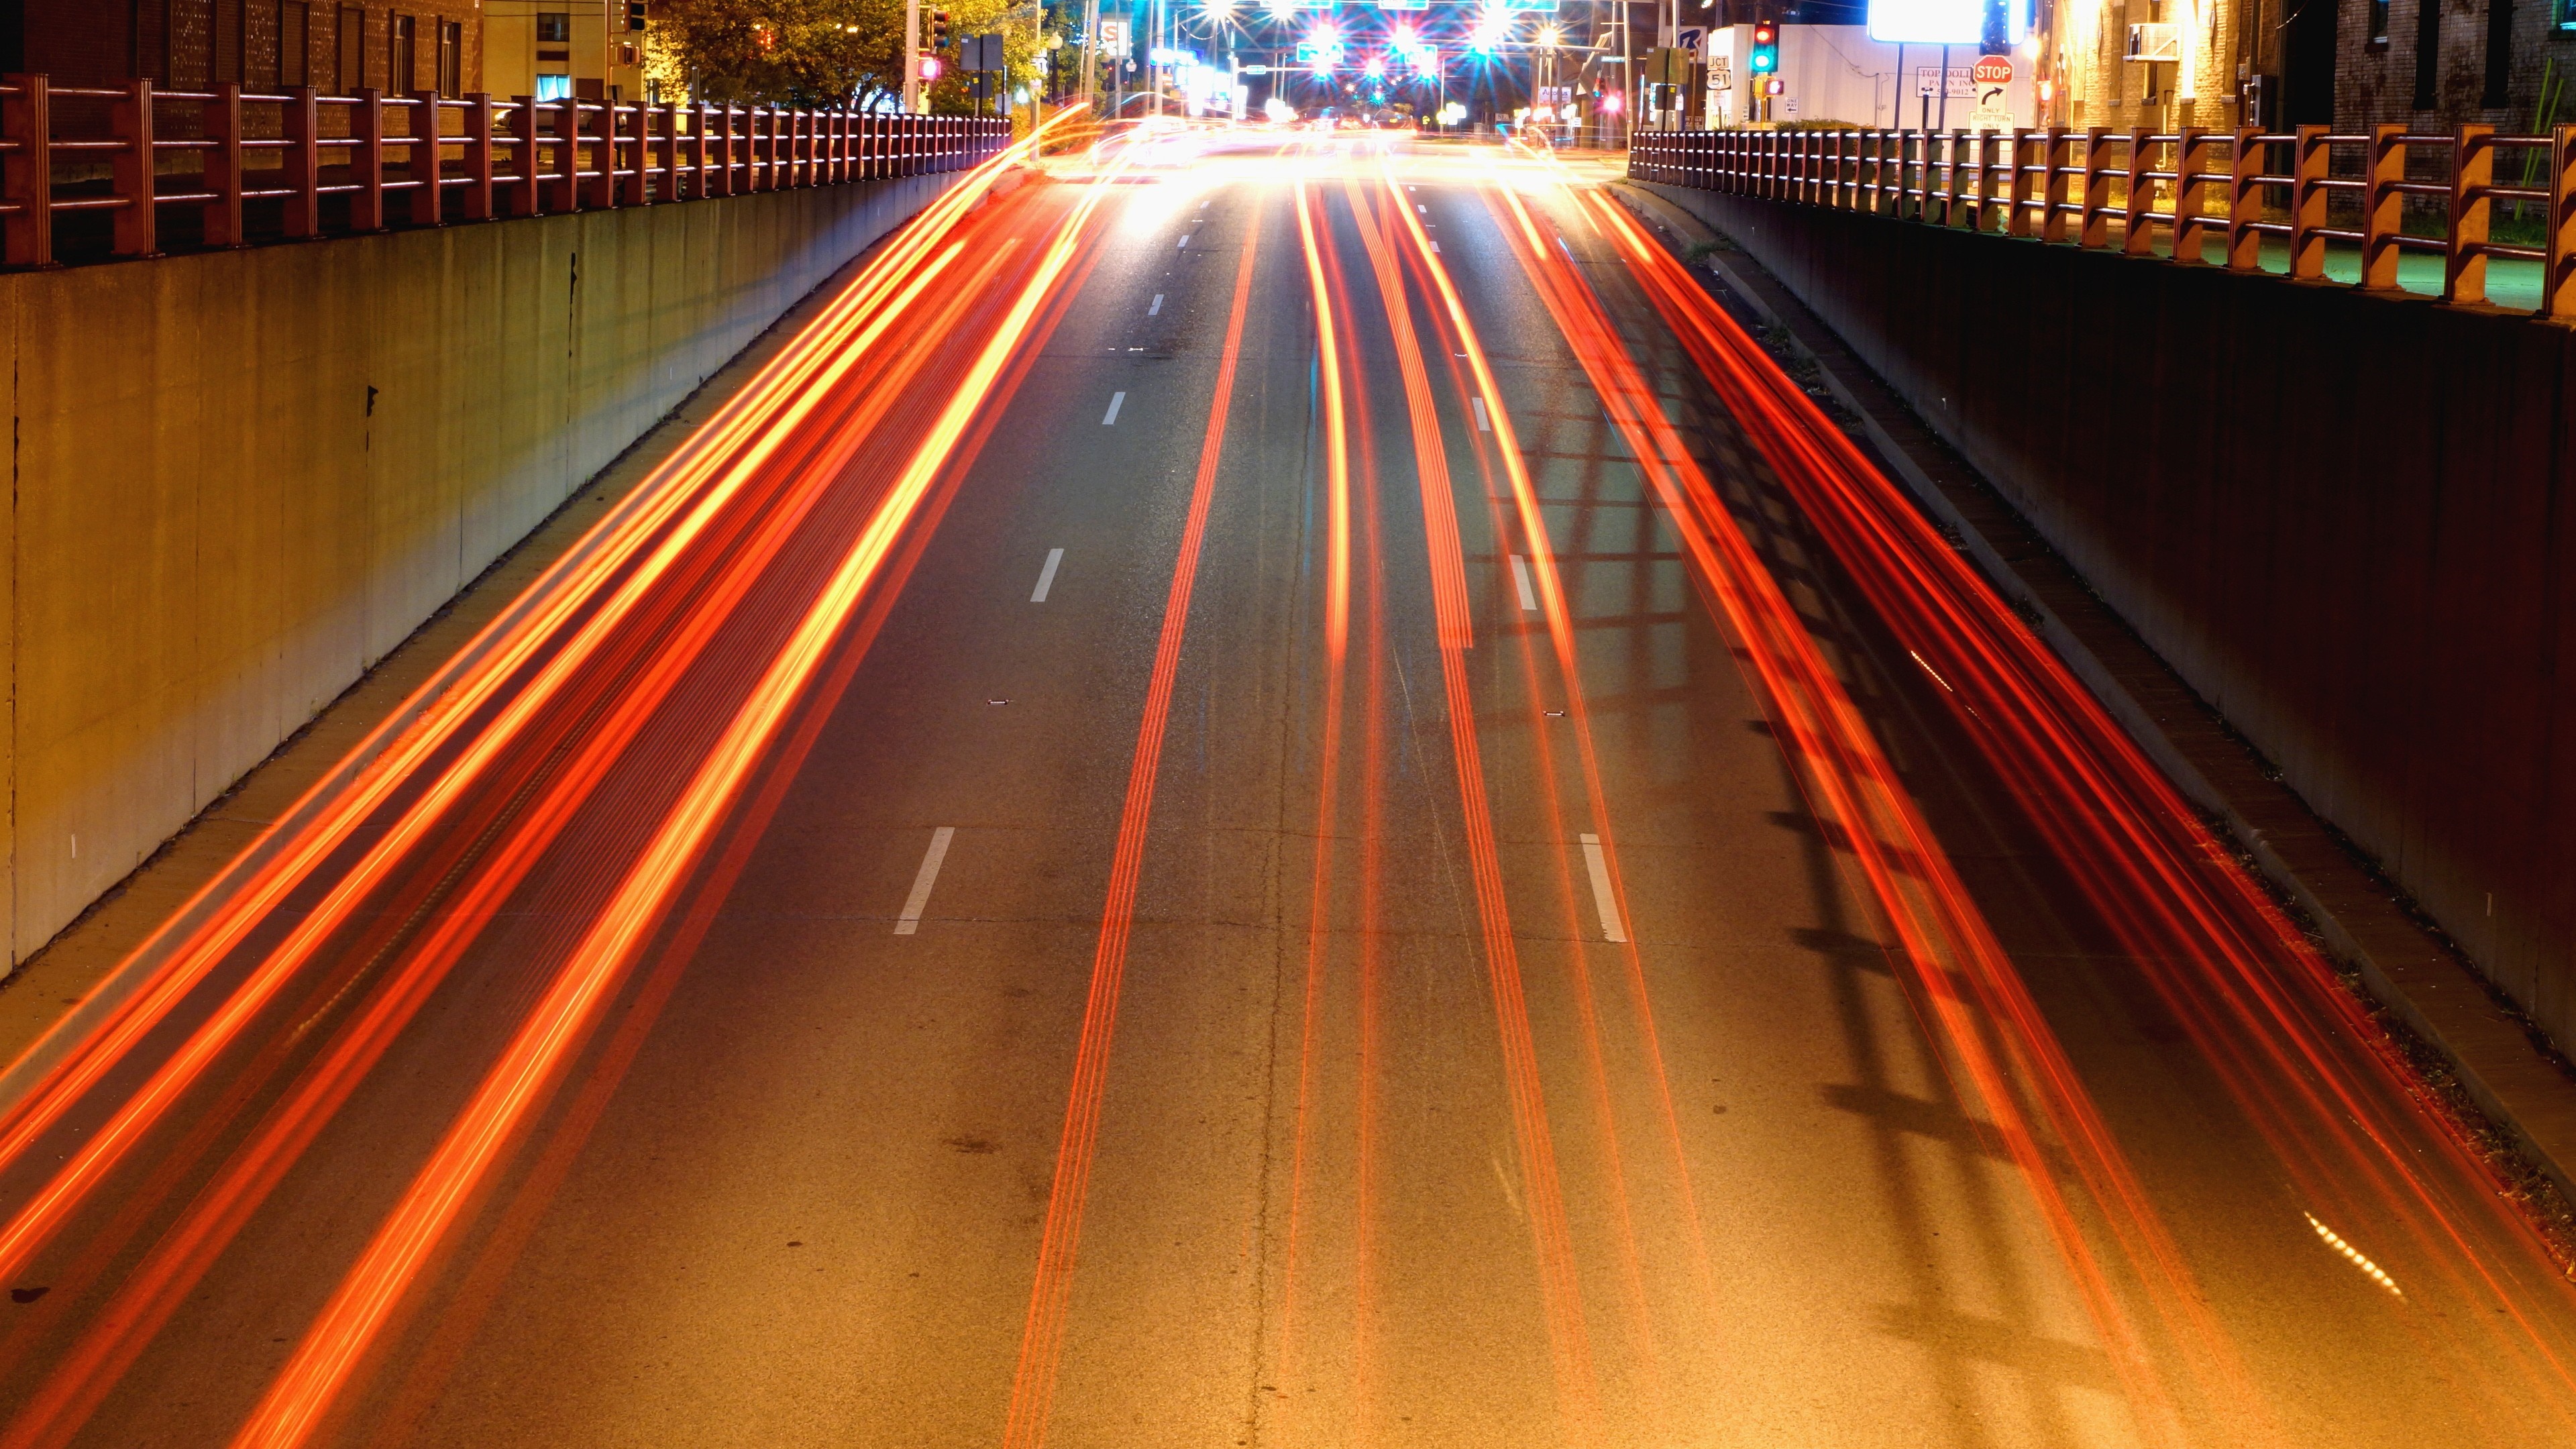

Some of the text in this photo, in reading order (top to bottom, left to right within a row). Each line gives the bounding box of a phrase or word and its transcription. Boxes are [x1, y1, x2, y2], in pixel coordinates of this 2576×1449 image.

[1711, 58, 1727, 66] JCT
[1921, 69, 1941, 77] TOP
[1976, 66, 2011, 79] STOP
[1712, 74, 1727, 85] 51
